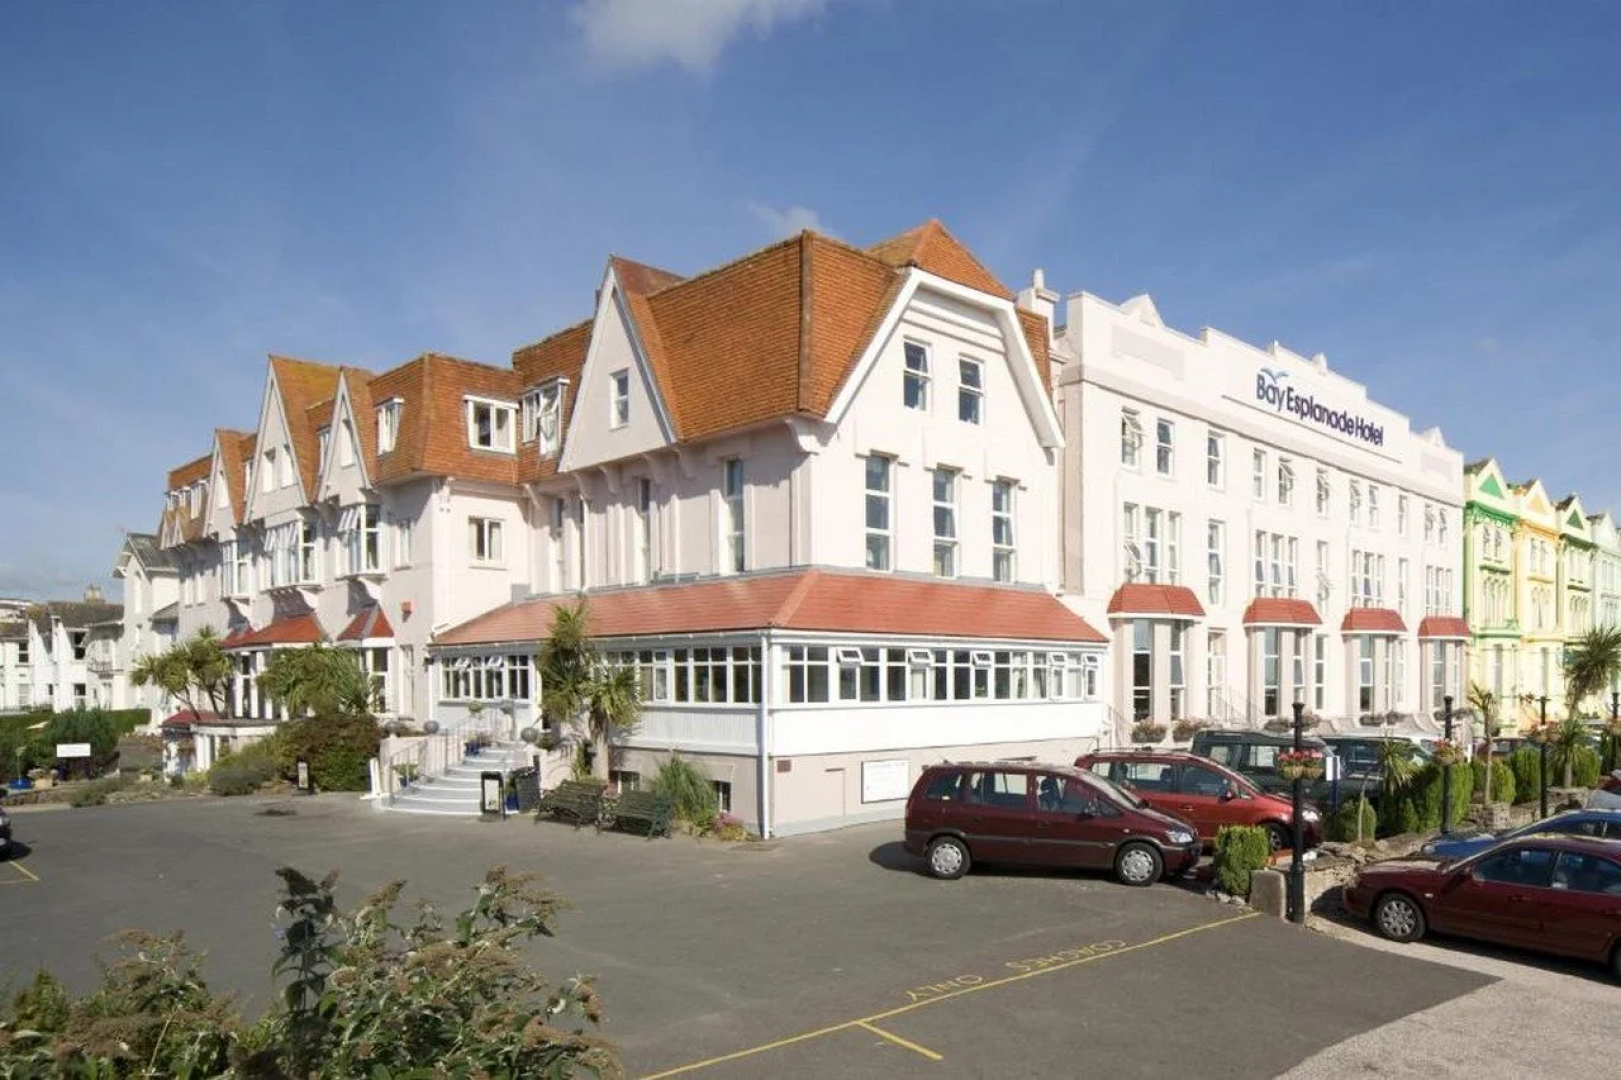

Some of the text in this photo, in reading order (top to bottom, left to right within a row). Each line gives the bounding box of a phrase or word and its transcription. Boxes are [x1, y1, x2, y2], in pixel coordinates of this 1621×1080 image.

[1256, 374, 1383, 446] Bay Esplanade Hotel
[906, 974, 983, 1001] ONLY
